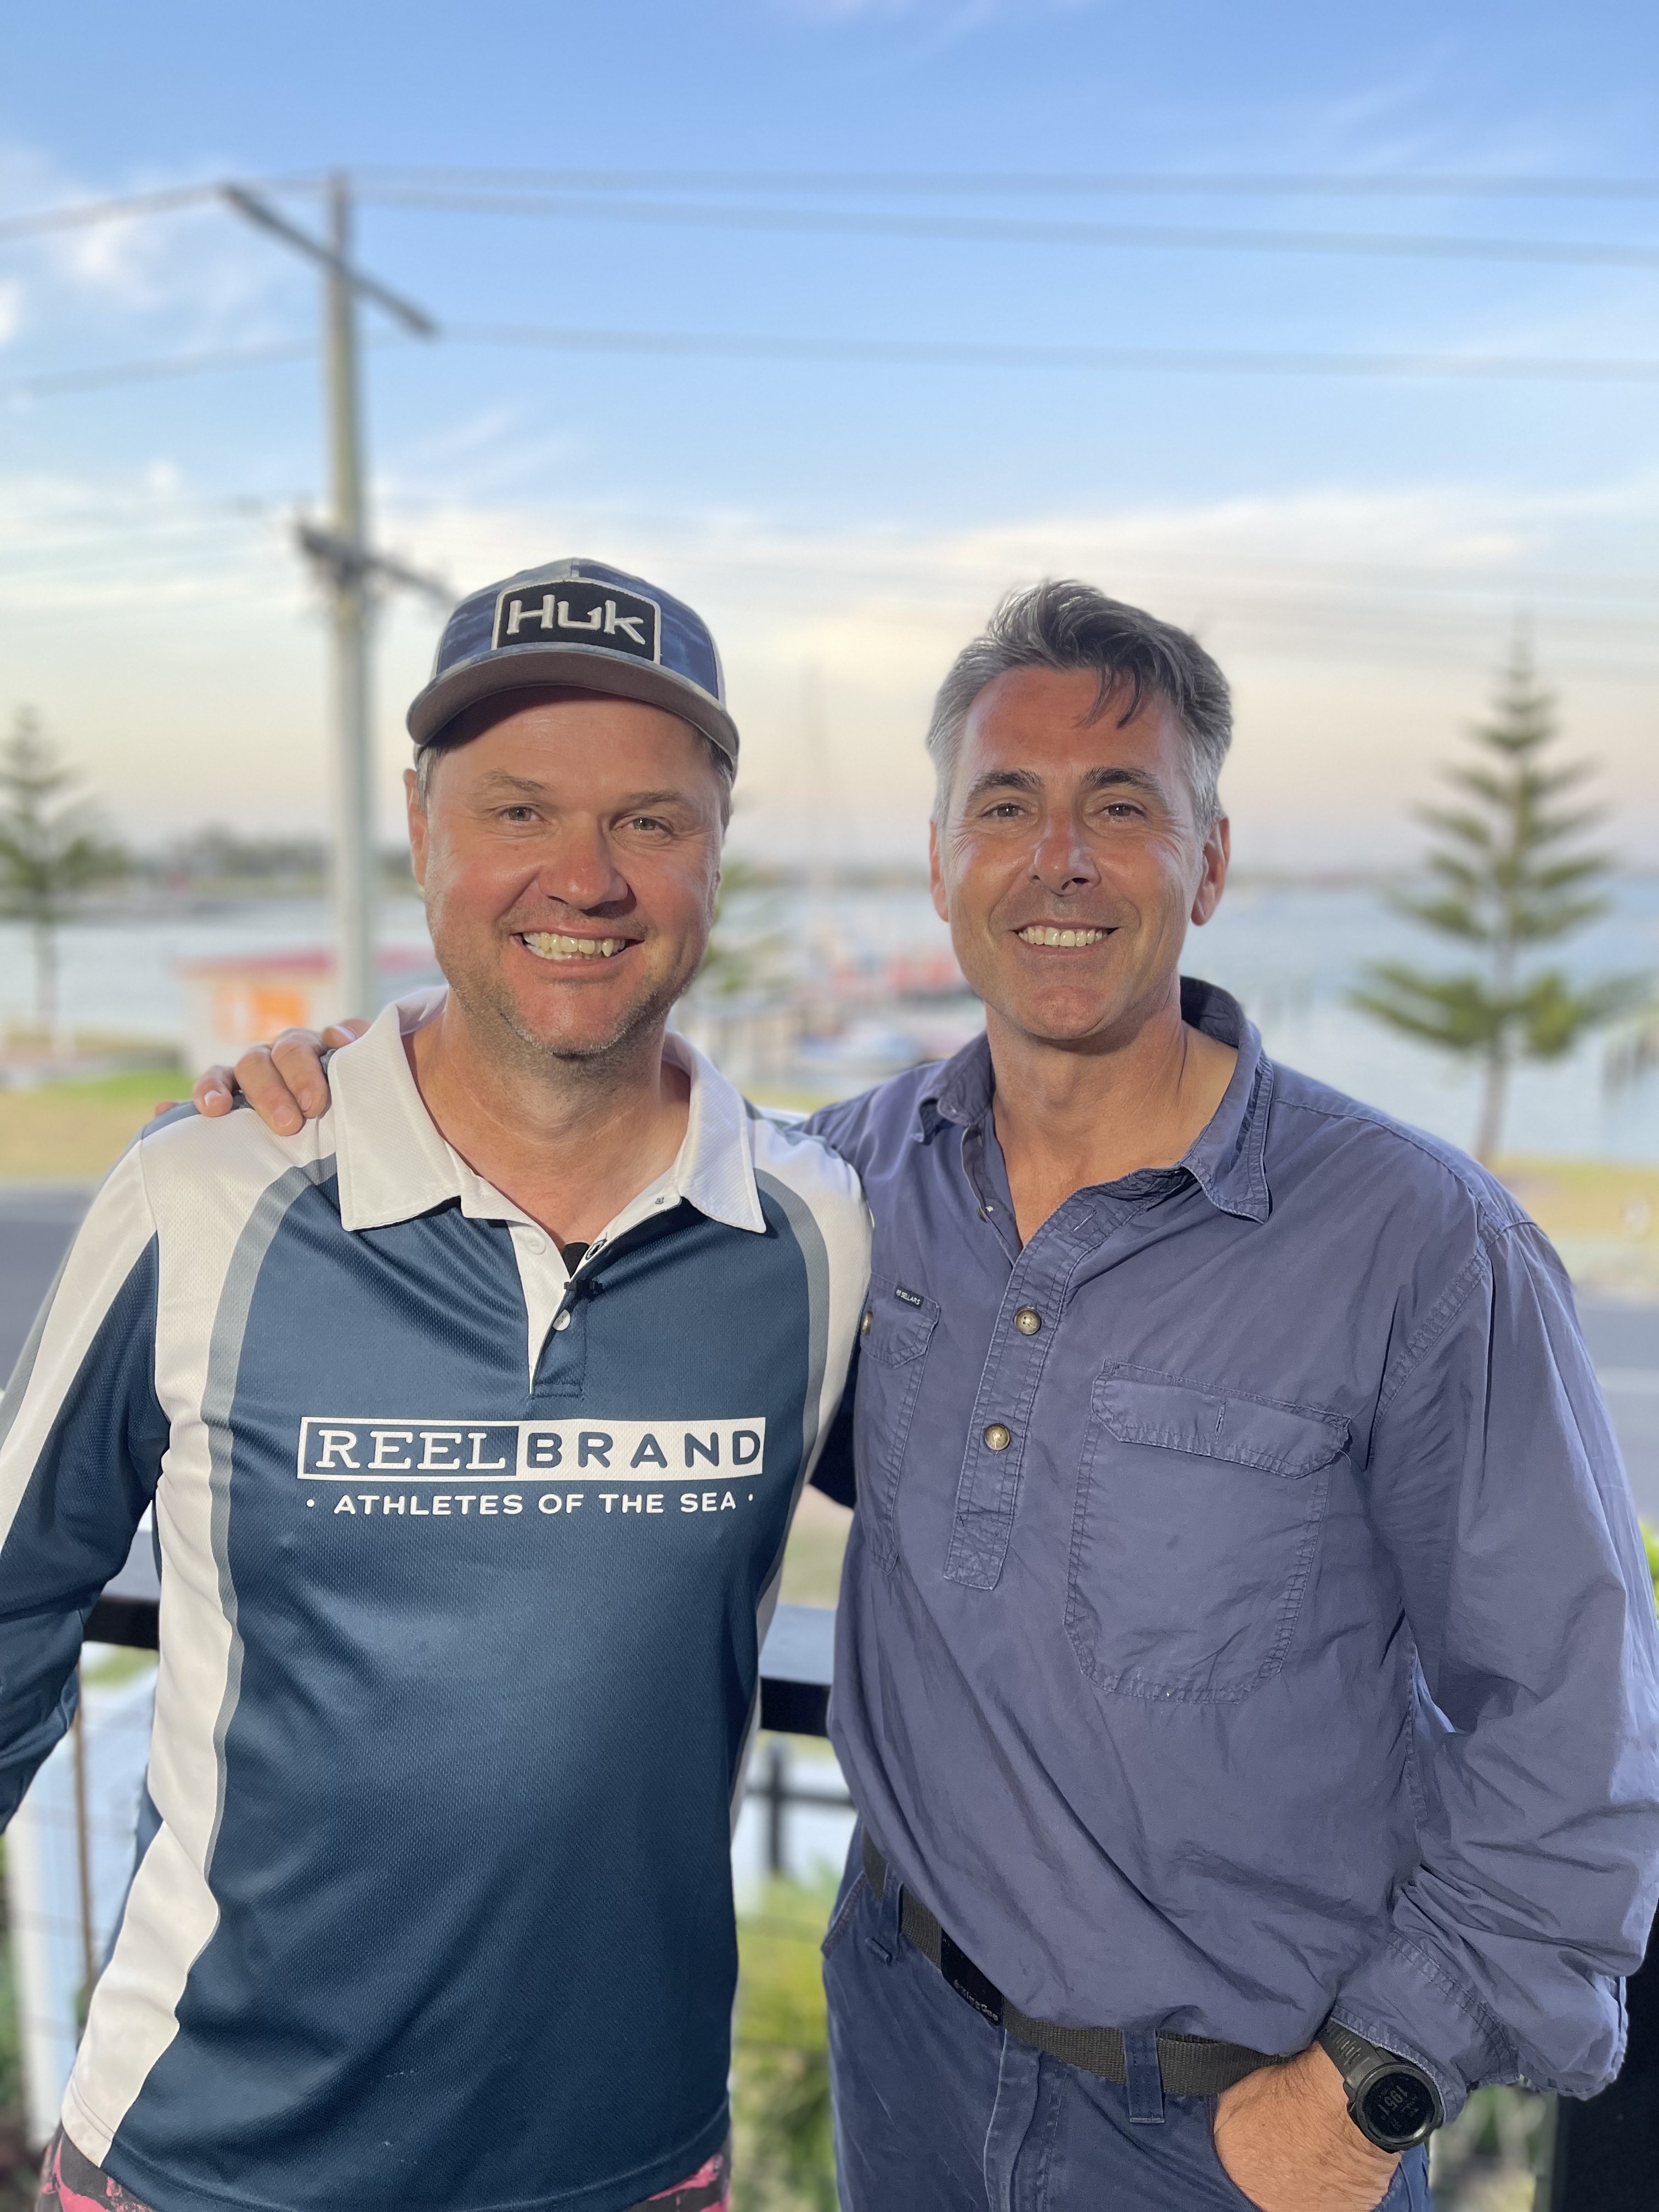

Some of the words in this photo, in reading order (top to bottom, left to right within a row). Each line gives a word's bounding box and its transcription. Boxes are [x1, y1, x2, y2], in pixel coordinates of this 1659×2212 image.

[315, 1430, 506, 1470] REEL
[527, 1430, 761, 1469] BRAND
[334, 1494, 523, 1515] ATHLETES
[538, 1493, 584, 1514] OF
[598, 1493, 664, 1514] THE
[680, 1491, 736, 1513] SEA
